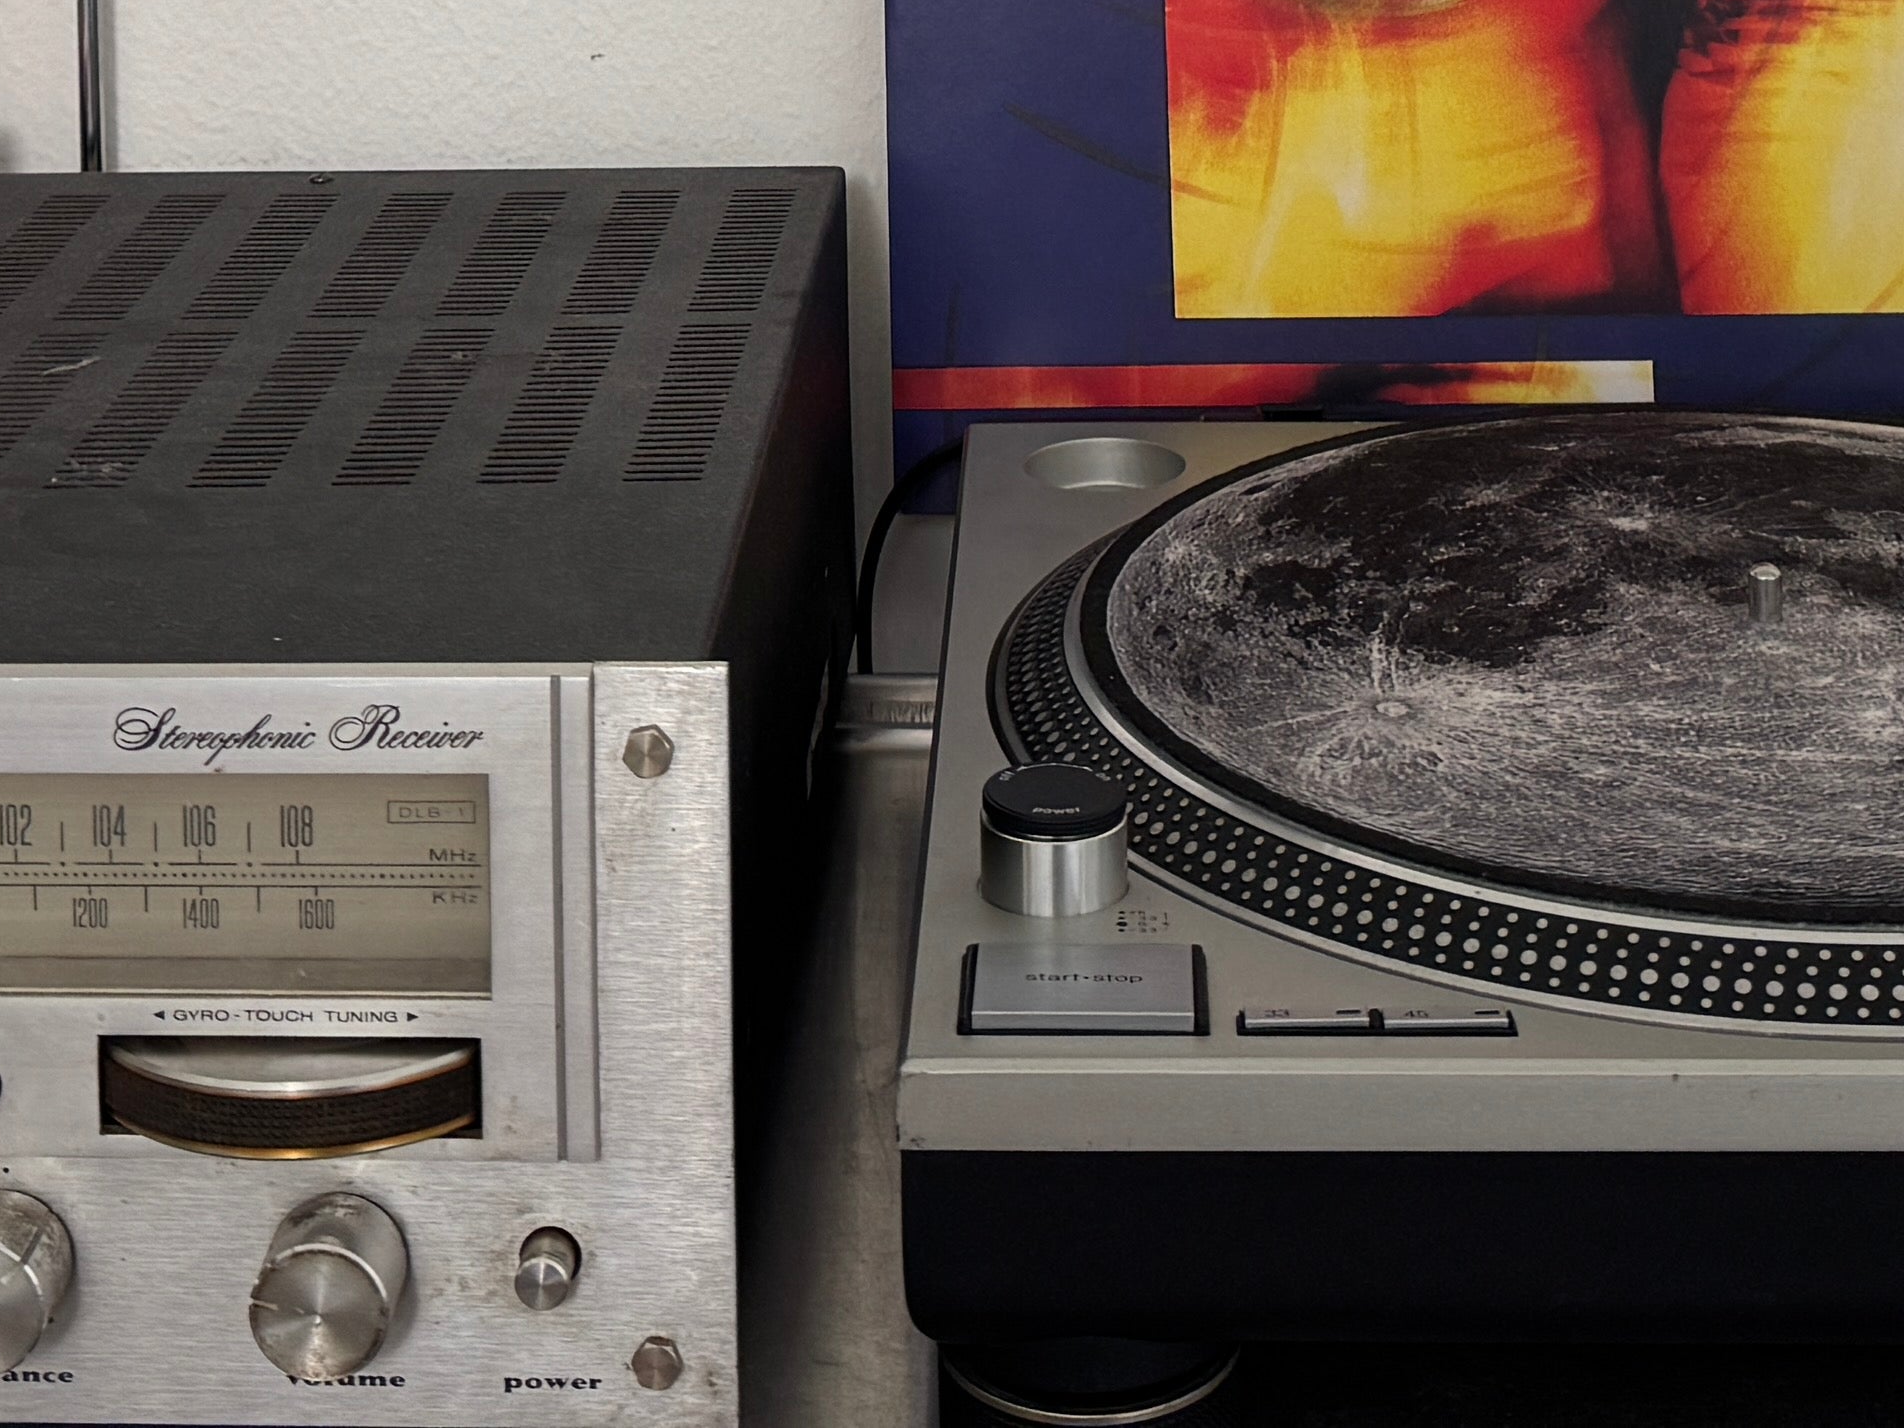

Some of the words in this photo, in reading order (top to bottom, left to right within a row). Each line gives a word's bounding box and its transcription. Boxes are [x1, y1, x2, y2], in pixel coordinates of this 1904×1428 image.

[113, 706, 317, 766] Stereophonic
[329, 704, 484, 751] Receiver
[92, 804, 127, 847] 104
[183, 804, 217, 847] 106
[279, 804, 314, 848] 108
[429, 848, 477, 862] MHz
[72, 898, 108, 929] 1200
[183, 898, 220, 930] 1400
[299, 899, 335, 931] 1600
[432, 891, 478, 904] KHz
[325, 1010, 398, 1023] TUNING
[503, 1375, 603, 1392] power
